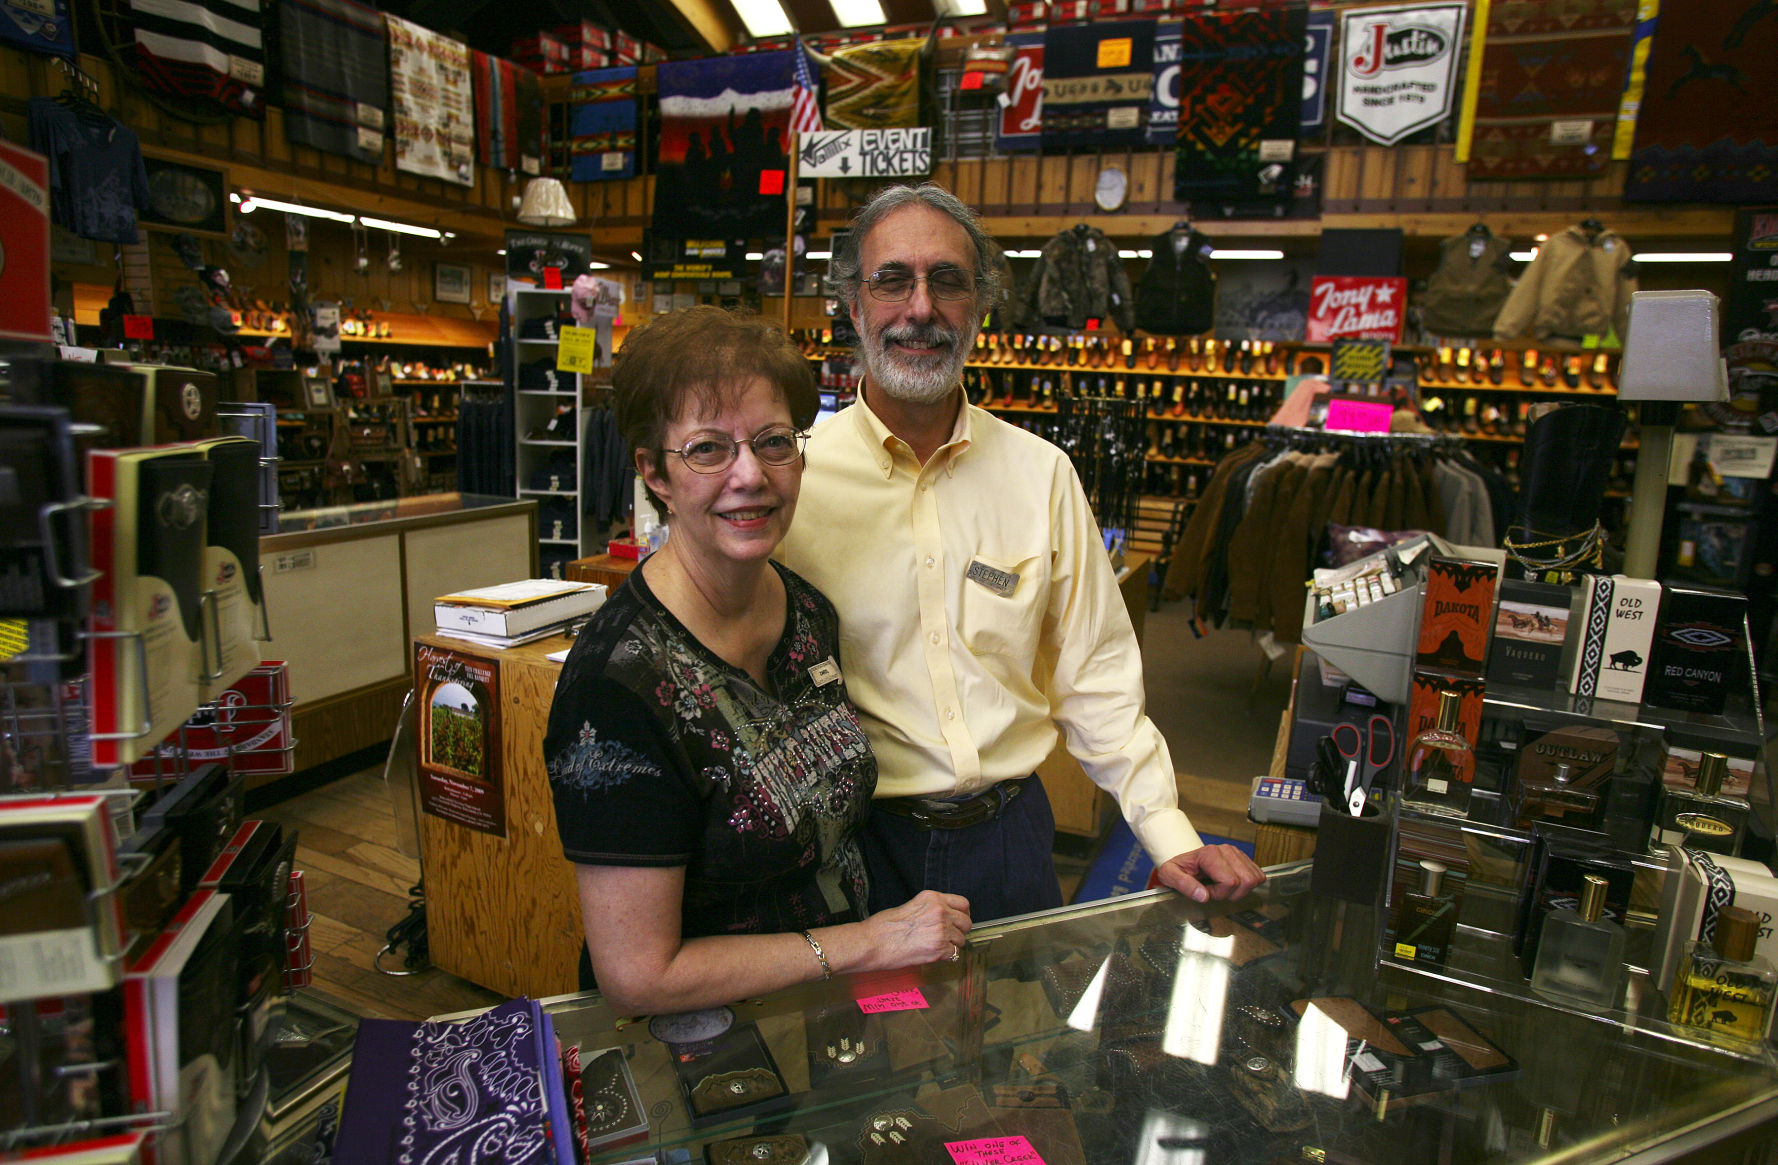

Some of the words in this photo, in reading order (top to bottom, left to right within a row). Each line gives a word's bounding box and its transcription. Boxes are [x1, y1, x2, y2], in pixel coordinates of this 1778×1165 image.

[1352, 23, 1441, 74] Justin
[1352, 81, 1438, 95] HANDCRAFTED
[860, 129, 929, 152] EVENT
[859, 149, 930, 175] TICKETS
[1314, 281, 1375, 319] Tony
[1323, 305, 1398, 337] Lama
[972, 566, 1010, 588] STEPHEN
[1433, 600, 1482, 625] DAKOTA
[1619, 597, 1643, 609] OLD
[1615, 608, 1645, 621] WEST
[1664, 665, 1684, 677] RED
[1684, 666, 1722, 684] CANYON
[1535, 742, 1603, 763] OUTLAW
[1715, 974, 1745, 988] OLD
